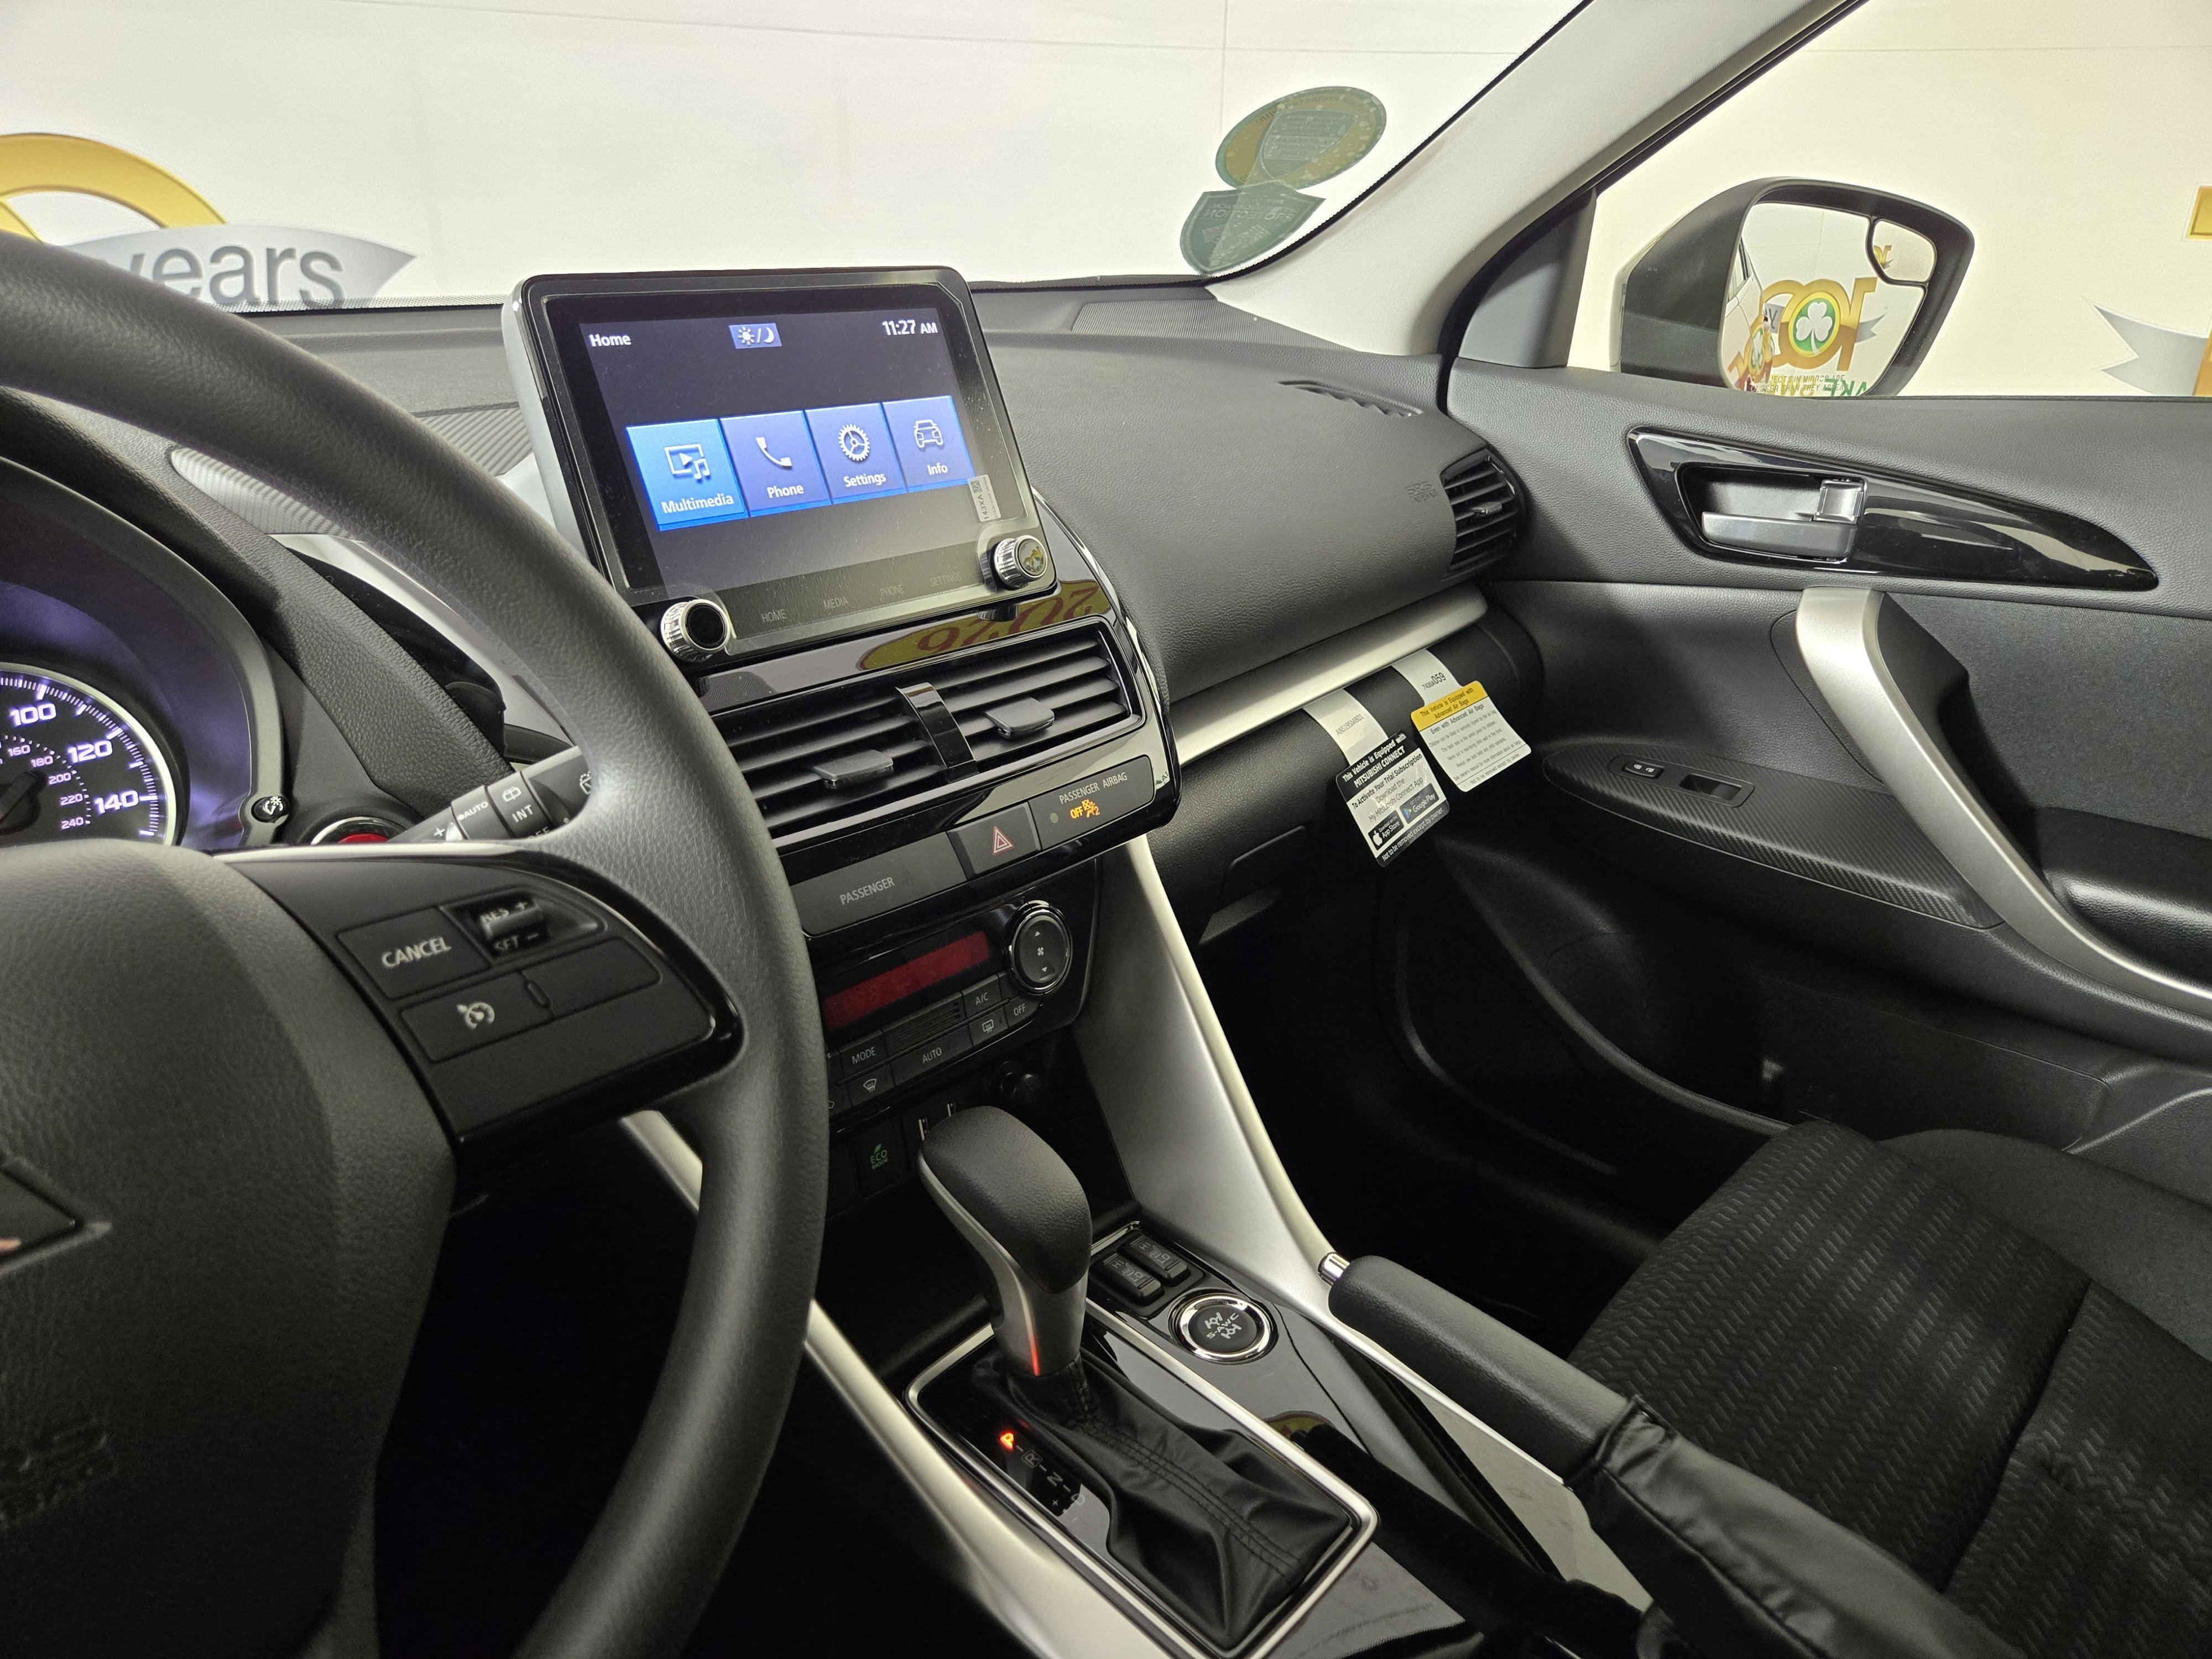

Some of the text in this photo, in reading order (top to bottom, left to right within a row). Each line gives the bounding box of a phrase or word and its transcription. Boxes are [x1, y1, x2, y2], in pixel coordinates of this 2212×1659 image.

[883, 320, 938, 335] 11:27 AM
[589, 333, 631, 347] Home
[927, 463, 948, 476] Info
[843, 472, 886, 489] Settings
[766, 483, 804, 499] Phone
[661, 493, 734, 514] Multimedia
[978, 494, 989, 519] 143XA
[930, 572, 962, 587] SETTINGS
[880, 585, 905, 597] PHONE
[823, 596, 849, 611] MEDIA
[761, 609, 787, 623] HOME
[1420, 709, 1430, 717] This
[1430, 702, 1443, 712] Vehicle
[1448, 691, 1465, 703] Equipped
[1465, 686, 1474, 695] with
[1434, 706, 1452, 719] Advanced
[1459, 698, 1469, 707] Bags
[11, 703, 56, 727] 100
[1430, 726, 1440, 734] Even
[1450, 711, 1467, 723] Advanced
[1474, 703, 1484, 712] Bags
[8, 745, 30, 757] 160
[67, 741, 113, 764] 120
[1343, 732, 1405, 781] This Vehicle is Equipped with
[30, 755, 54, 768] 180
[1354, 745, 1406, 787] MITSUBISHI CONNECT
[49, 772, 71, 785] 200
[1352, 753, 1422, 809] To Activate Your Trial Subscription
[1059, 772, 1128, 804] PASSENGER AIRBAG
[1375, 797, 1396, 816] Mitsubishi
[1395, 784, 1413, 800] Connect
[1413, 776, 1423, 787] App
[1376, 778, 1405, 802] Download the
[60, 793, 83, 806] 220
[95, 791, 139, 814] 140
[1412, 792, 1436, 813] Google Play
[463, 801, 488, 818] AUTO
[512, 805, 533, 823] INT
[1070, 806, 1083, 819] OFF
[61, 816, 85, 830] 240
[1381, 820, 1400, 838] App Store
[1381, 852, 1390, 860] Not
[1396, 831, 1413, 847] removed
[1412, 821, 1426, 834] except
[1425, 816, 1431, 825] by
[1430, 807, 1443, 820] owner.
[839, 877, 895, 905] PASSENGER
[382, 937, 452, 969] CANCEL
[975, 992, 989, 1005] A/C
[1014, 1003, 1026, 1016] OFF
[852, 1046, 877, 1065] MODE
[922, 1047, 942, 1063] AUTO
[870, 1150, 888, 1165] ECO
[872, 1156, 889, 1170] MODE
[1206, 1312, 1239, 1339] S-AWC
[1000, 1432, 1015, 1451] P
[1025, 1453, 1041, 1466] R
[1046, 1471, 1063, 1487] N
